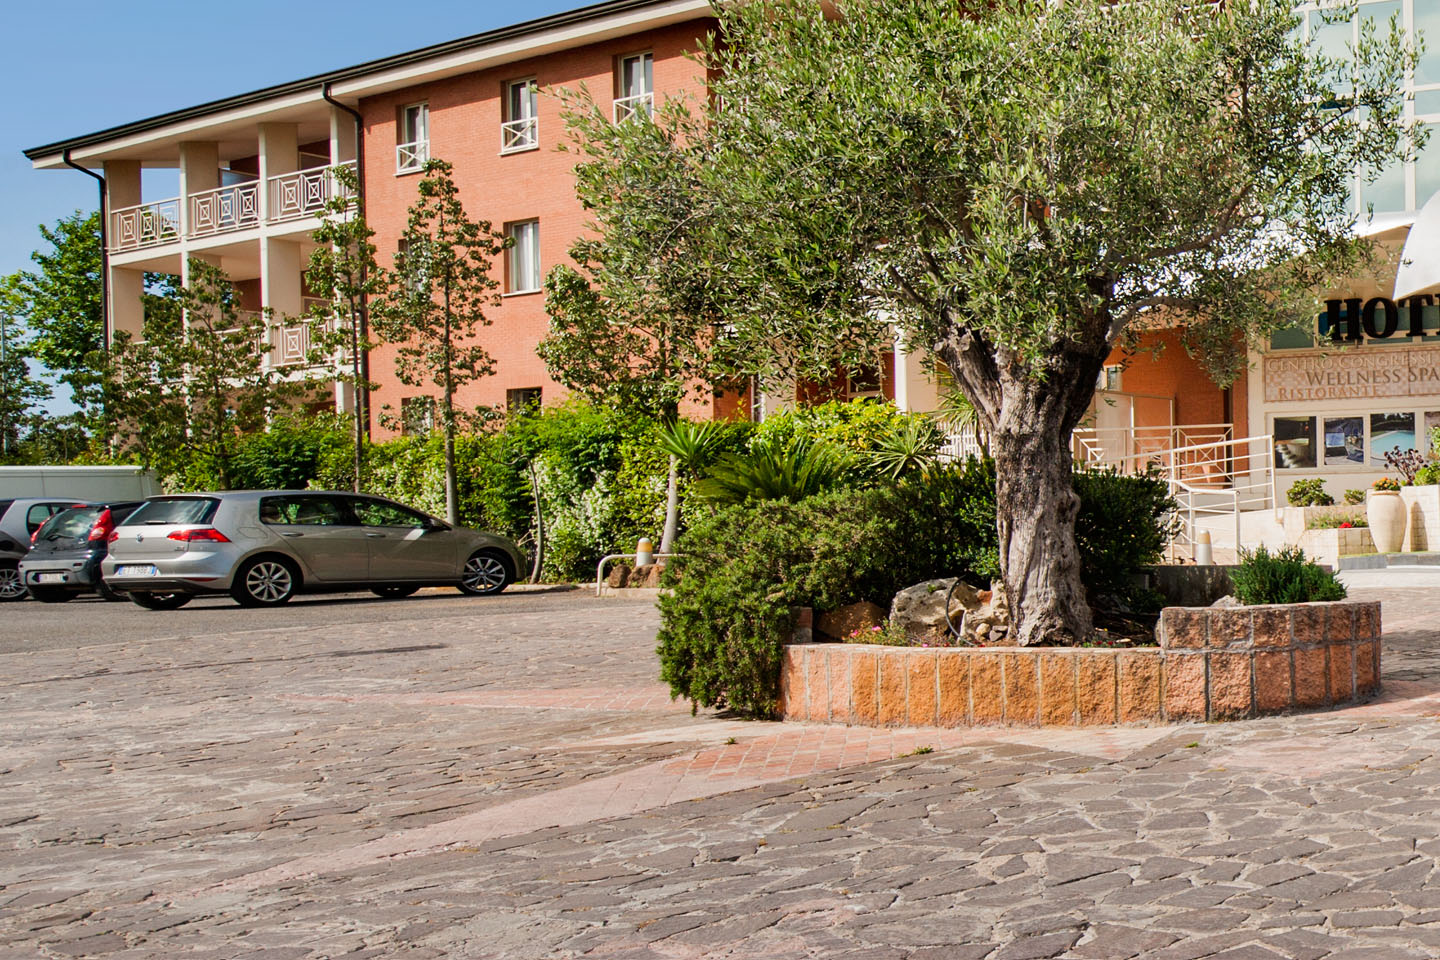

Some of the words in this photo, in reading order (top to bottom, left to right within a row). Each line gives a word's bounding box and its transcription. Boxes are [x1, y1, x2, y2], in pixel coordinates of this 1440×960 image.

[1268, 357, 1334, 372] CENTRO
[1339, 351, 1433, 370] CONGRESSI
[1306, 369, 1401, 386] WELLNESS
[1407, 366, 1440, 383] SPA
[1278, 384, 1381, 400] RISTORANTE
